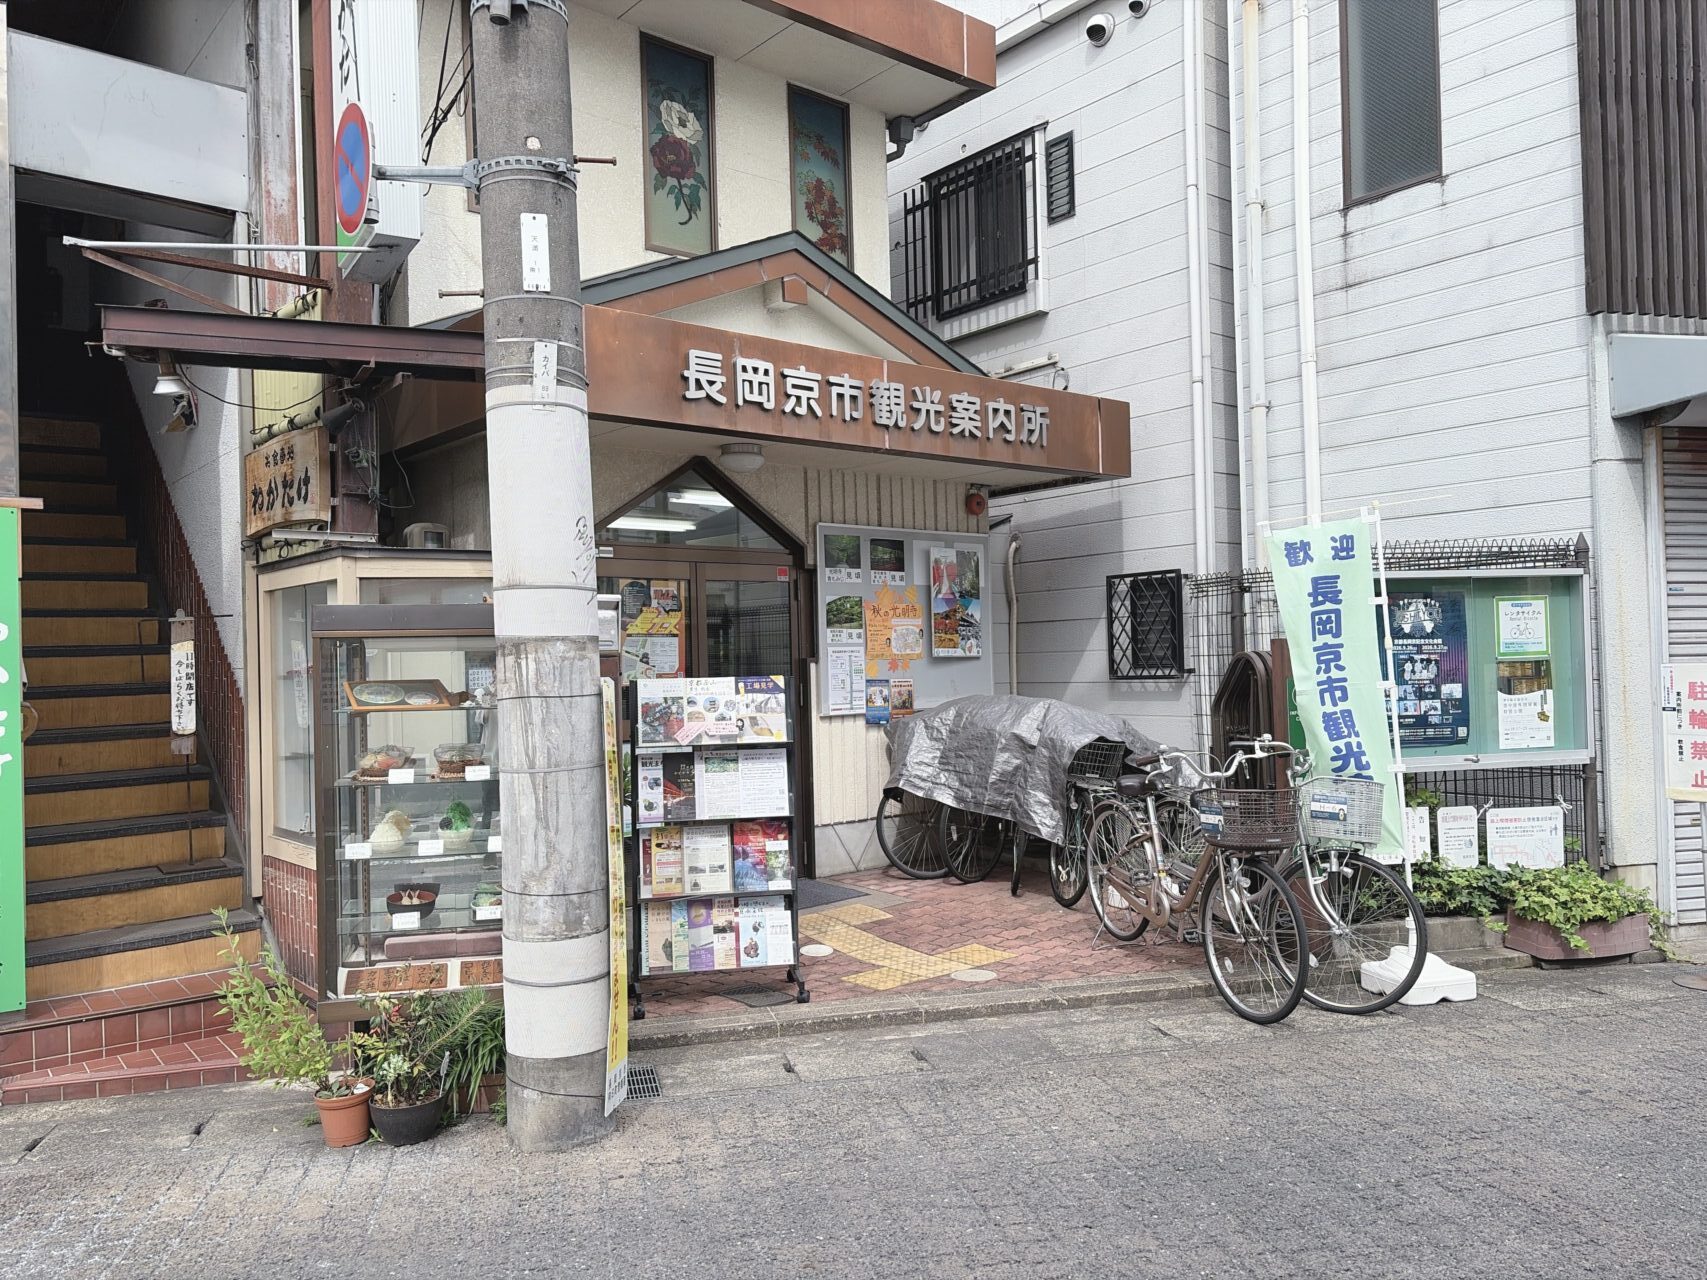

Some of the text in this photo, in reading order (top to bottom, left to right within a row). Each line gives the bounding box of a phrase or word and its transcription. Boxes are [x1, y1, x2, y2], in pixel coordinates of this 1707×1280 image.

[681, 349, 1050, 447] 長岡京市観光案内所
[251, 465, 311, 516] わかたけ
[1284, 534, 1355, 567] 歓迎
[871, 604, 917, 618] 秋の光明寺
[745, 681, 775, 691] 工場見学
